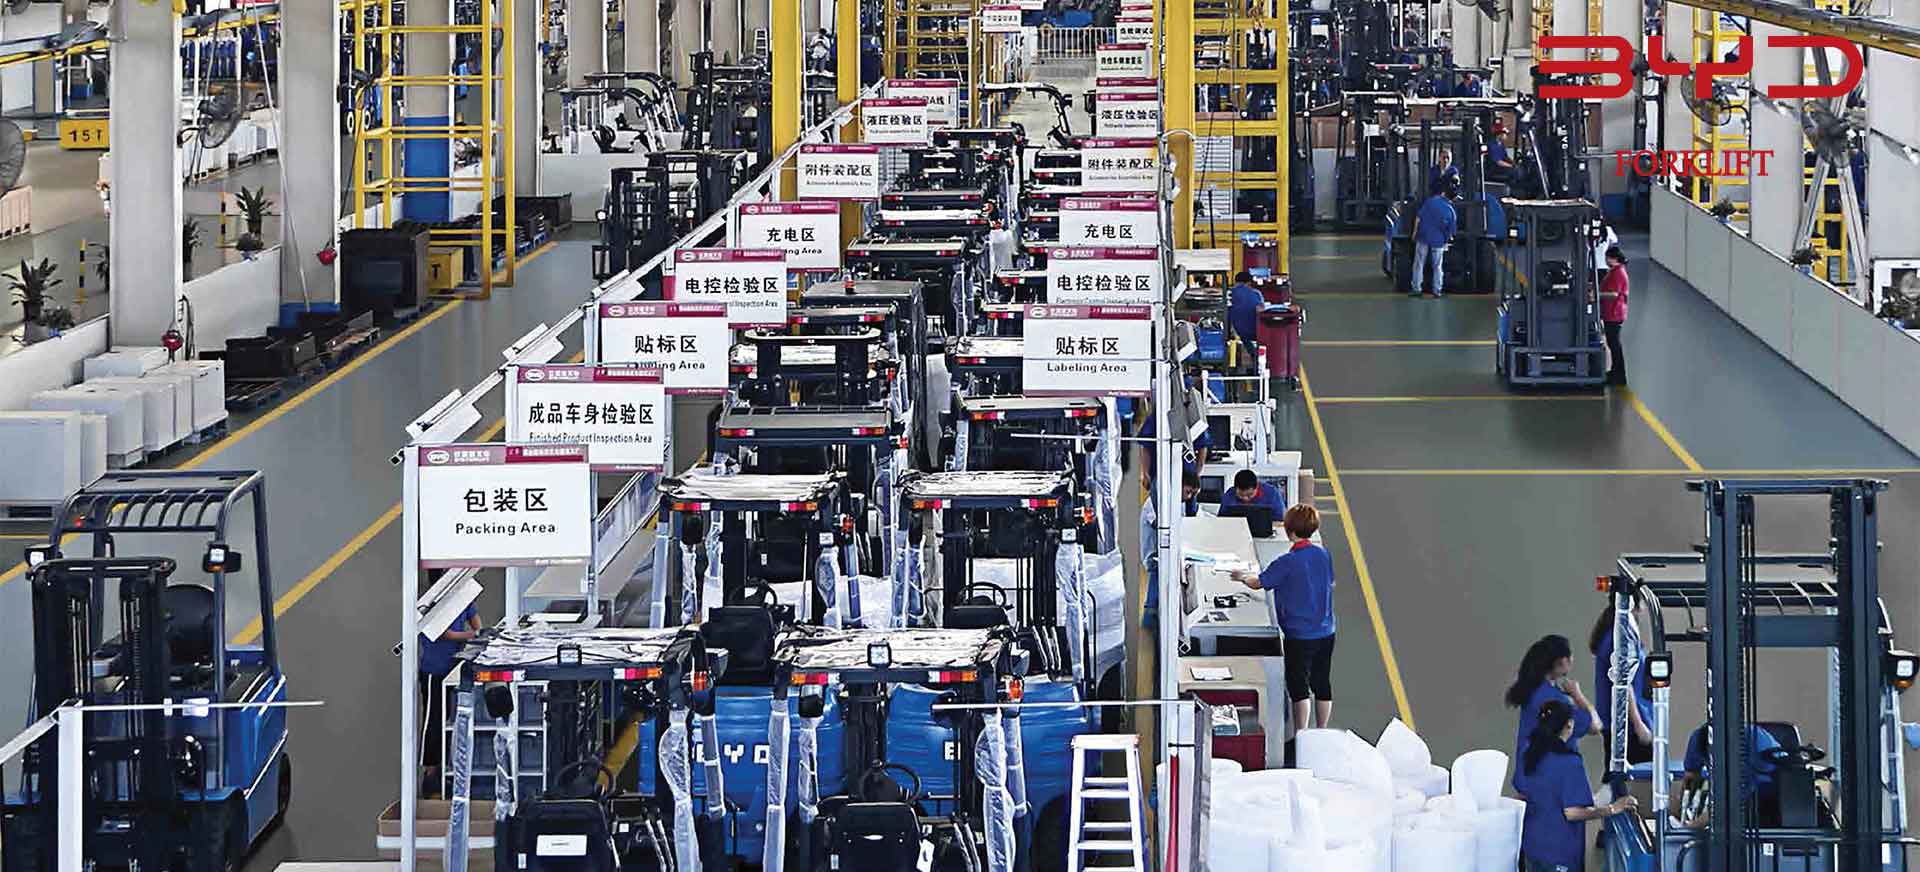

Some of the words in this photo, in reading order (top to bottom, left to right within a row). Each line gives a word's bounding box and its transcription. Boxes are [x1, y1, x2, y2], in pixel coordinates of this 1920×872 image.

[767, 228, 815, 243] 充电区
[1085, 224, 1133, 239] 充电区
[801, 247, 822, 255] Area
[685, 277, 779, 294] 电控检验区
[1057, 274, 1151, 291] 电控检验区
[635, 335, 698, 354] 贴标区
[1056, 336, 1120, 356] 贴标区
[679, 360, 705, 370] Area
[1047, 362, 1097, 374] Labeling
[1099, 362, 1127, 373] Area
[529, 402, 654, 425] 成品车身检验区
[563, 432, 592, 443] Product
[593, 432, 633, 445] Inspection
[634, 433, 652, 443] Area
[464, 488, 548, 513] 包装区
[455, 523, 516, 536] Packing
[521, 522, 556, 534] Area
